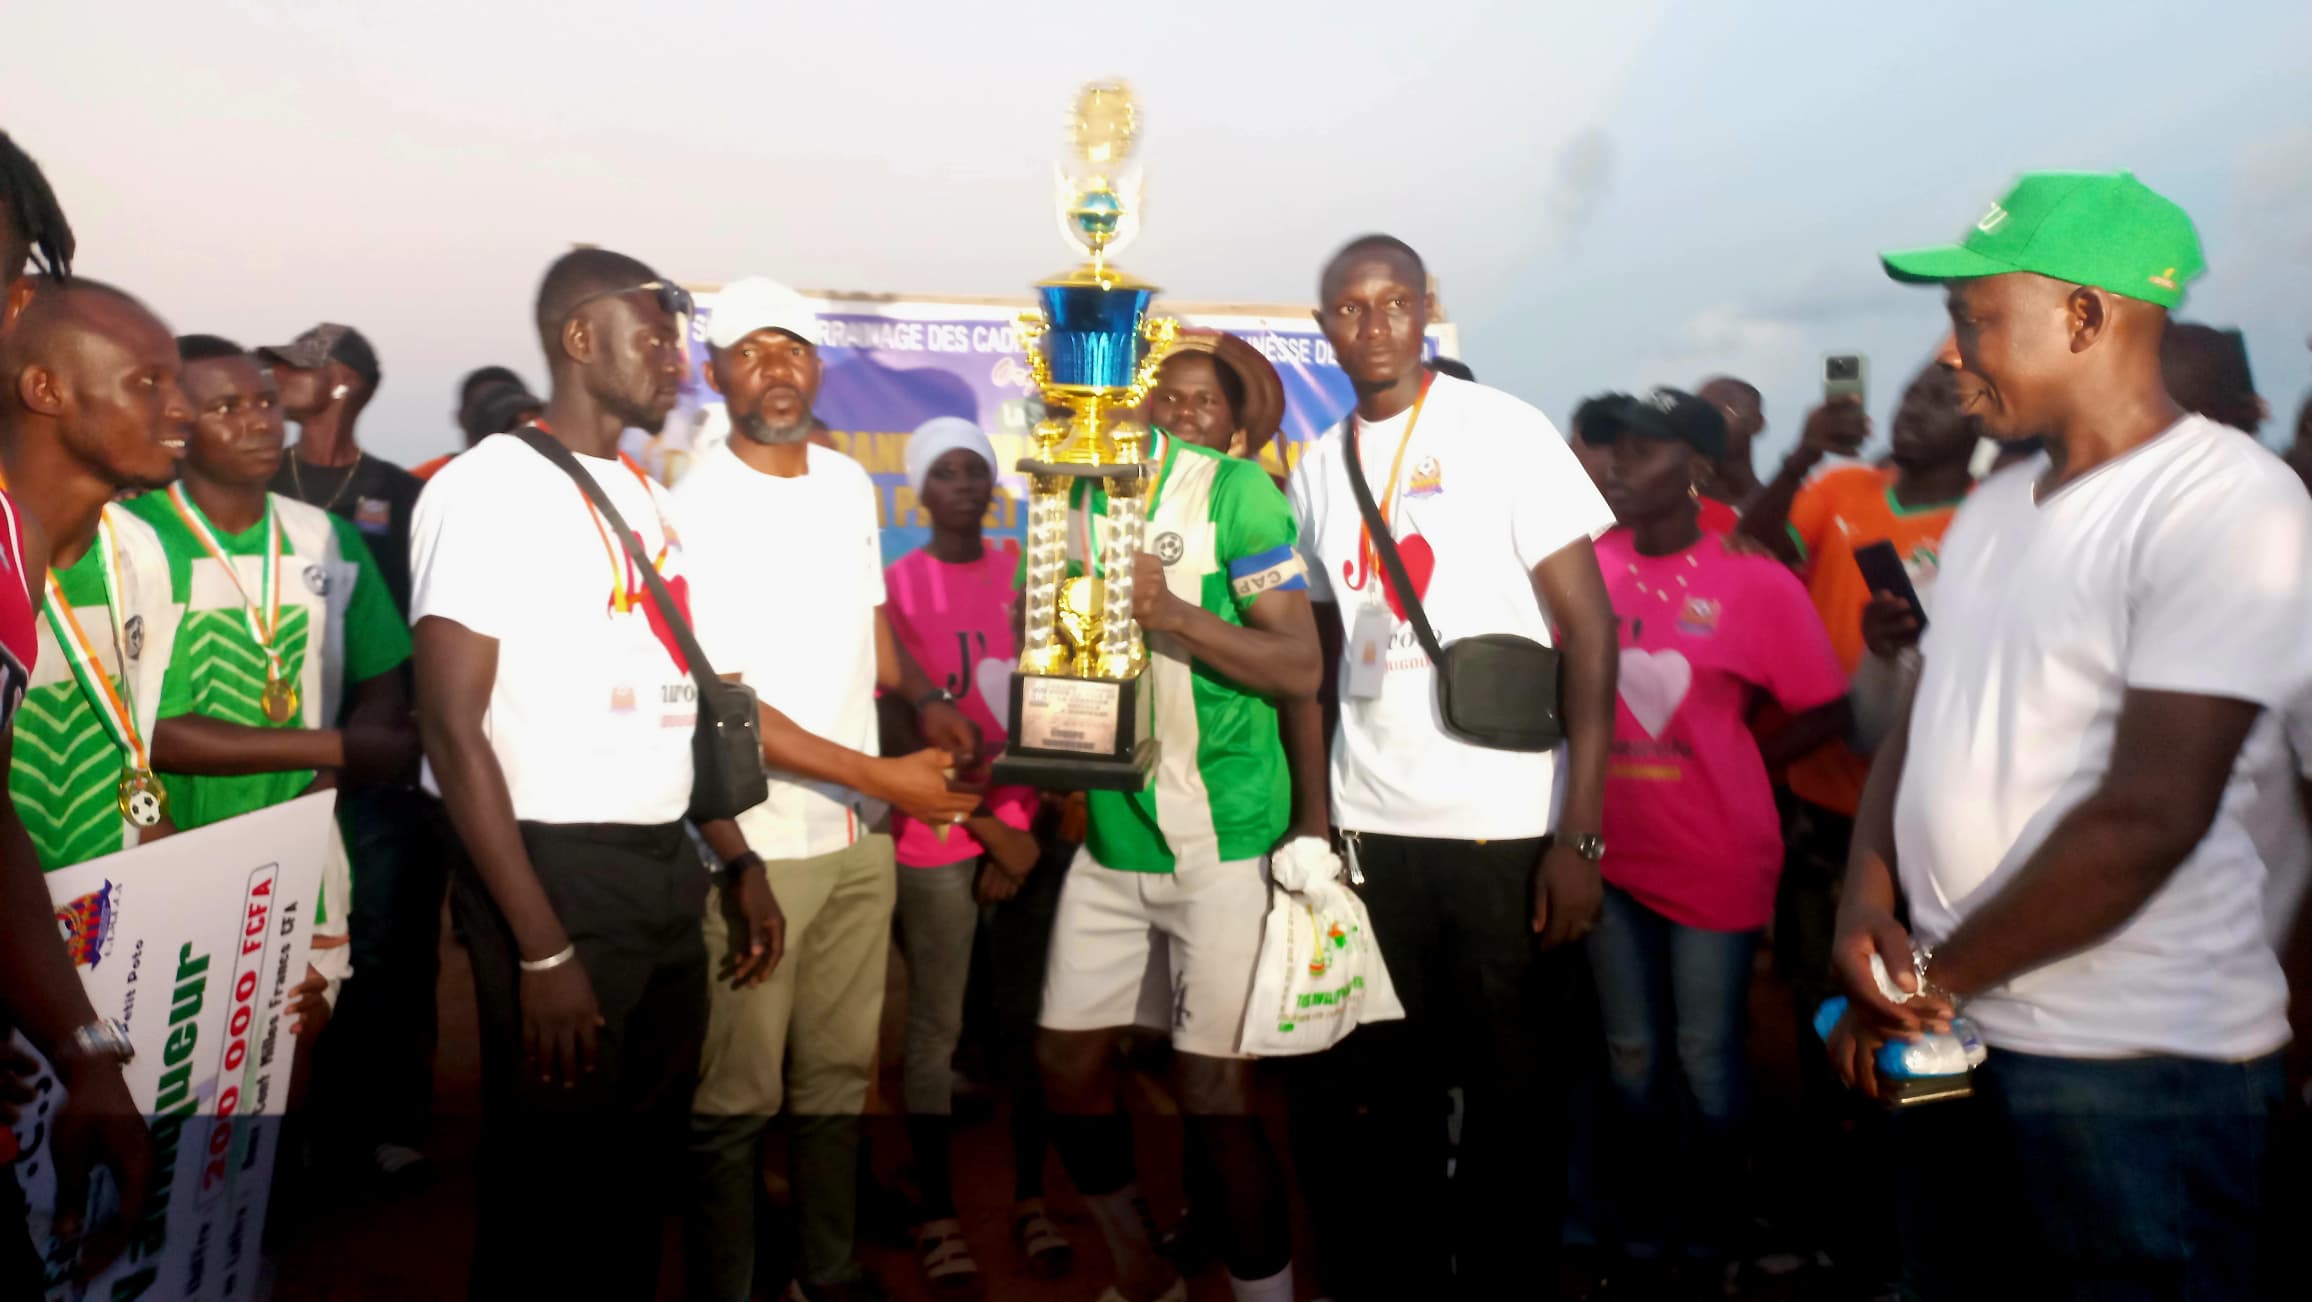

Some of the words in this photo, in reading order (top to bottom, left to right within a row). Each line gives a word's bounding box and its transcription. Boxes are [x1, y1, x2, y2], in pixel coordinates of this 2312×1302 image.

[927, 324, 970, 353] DES
[280, 901, 299, 936] CFA
[269, 943, 292, 1008] Francs
[203, 1086, 238, 1190] 200
[225, 969, 257, 1072] 000
[241, 877, 273, 955] FCFA
